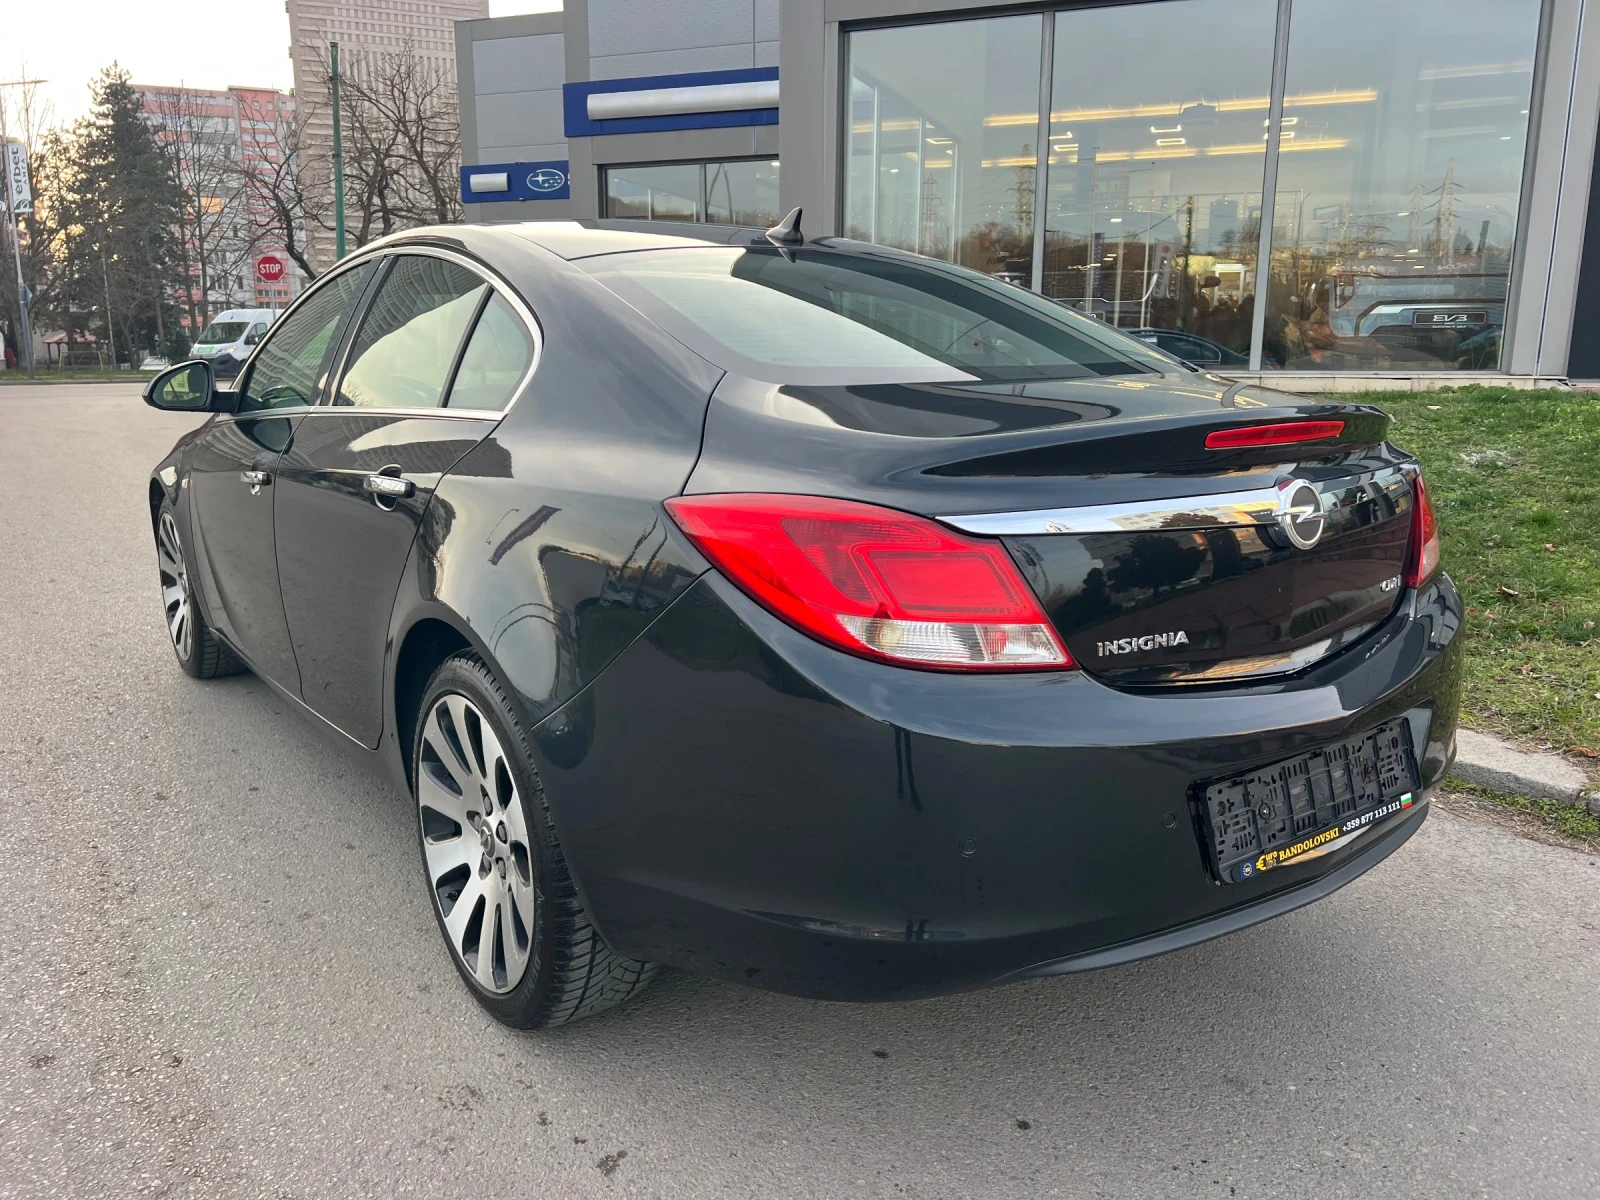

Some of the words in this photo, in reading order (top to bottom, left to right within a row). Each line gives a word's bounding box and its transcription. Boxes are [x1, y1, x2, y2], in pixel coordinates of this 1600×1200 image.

[11, 147, 23, 195] efbet
[260, 263, 281, 274] STOP
[1432, 314, 1468, 322] EV3
[1096, 630, 1190, 657] INSIGNIA
[1278, 827, 1339, 861] BANDOLOVSKI
[1342, 817, 1361, 832] +359
[1360, 811, 1374, 824] 877
[1374, 806, 1388, 819] 113
[1388, 800, 1401, 813] 111
